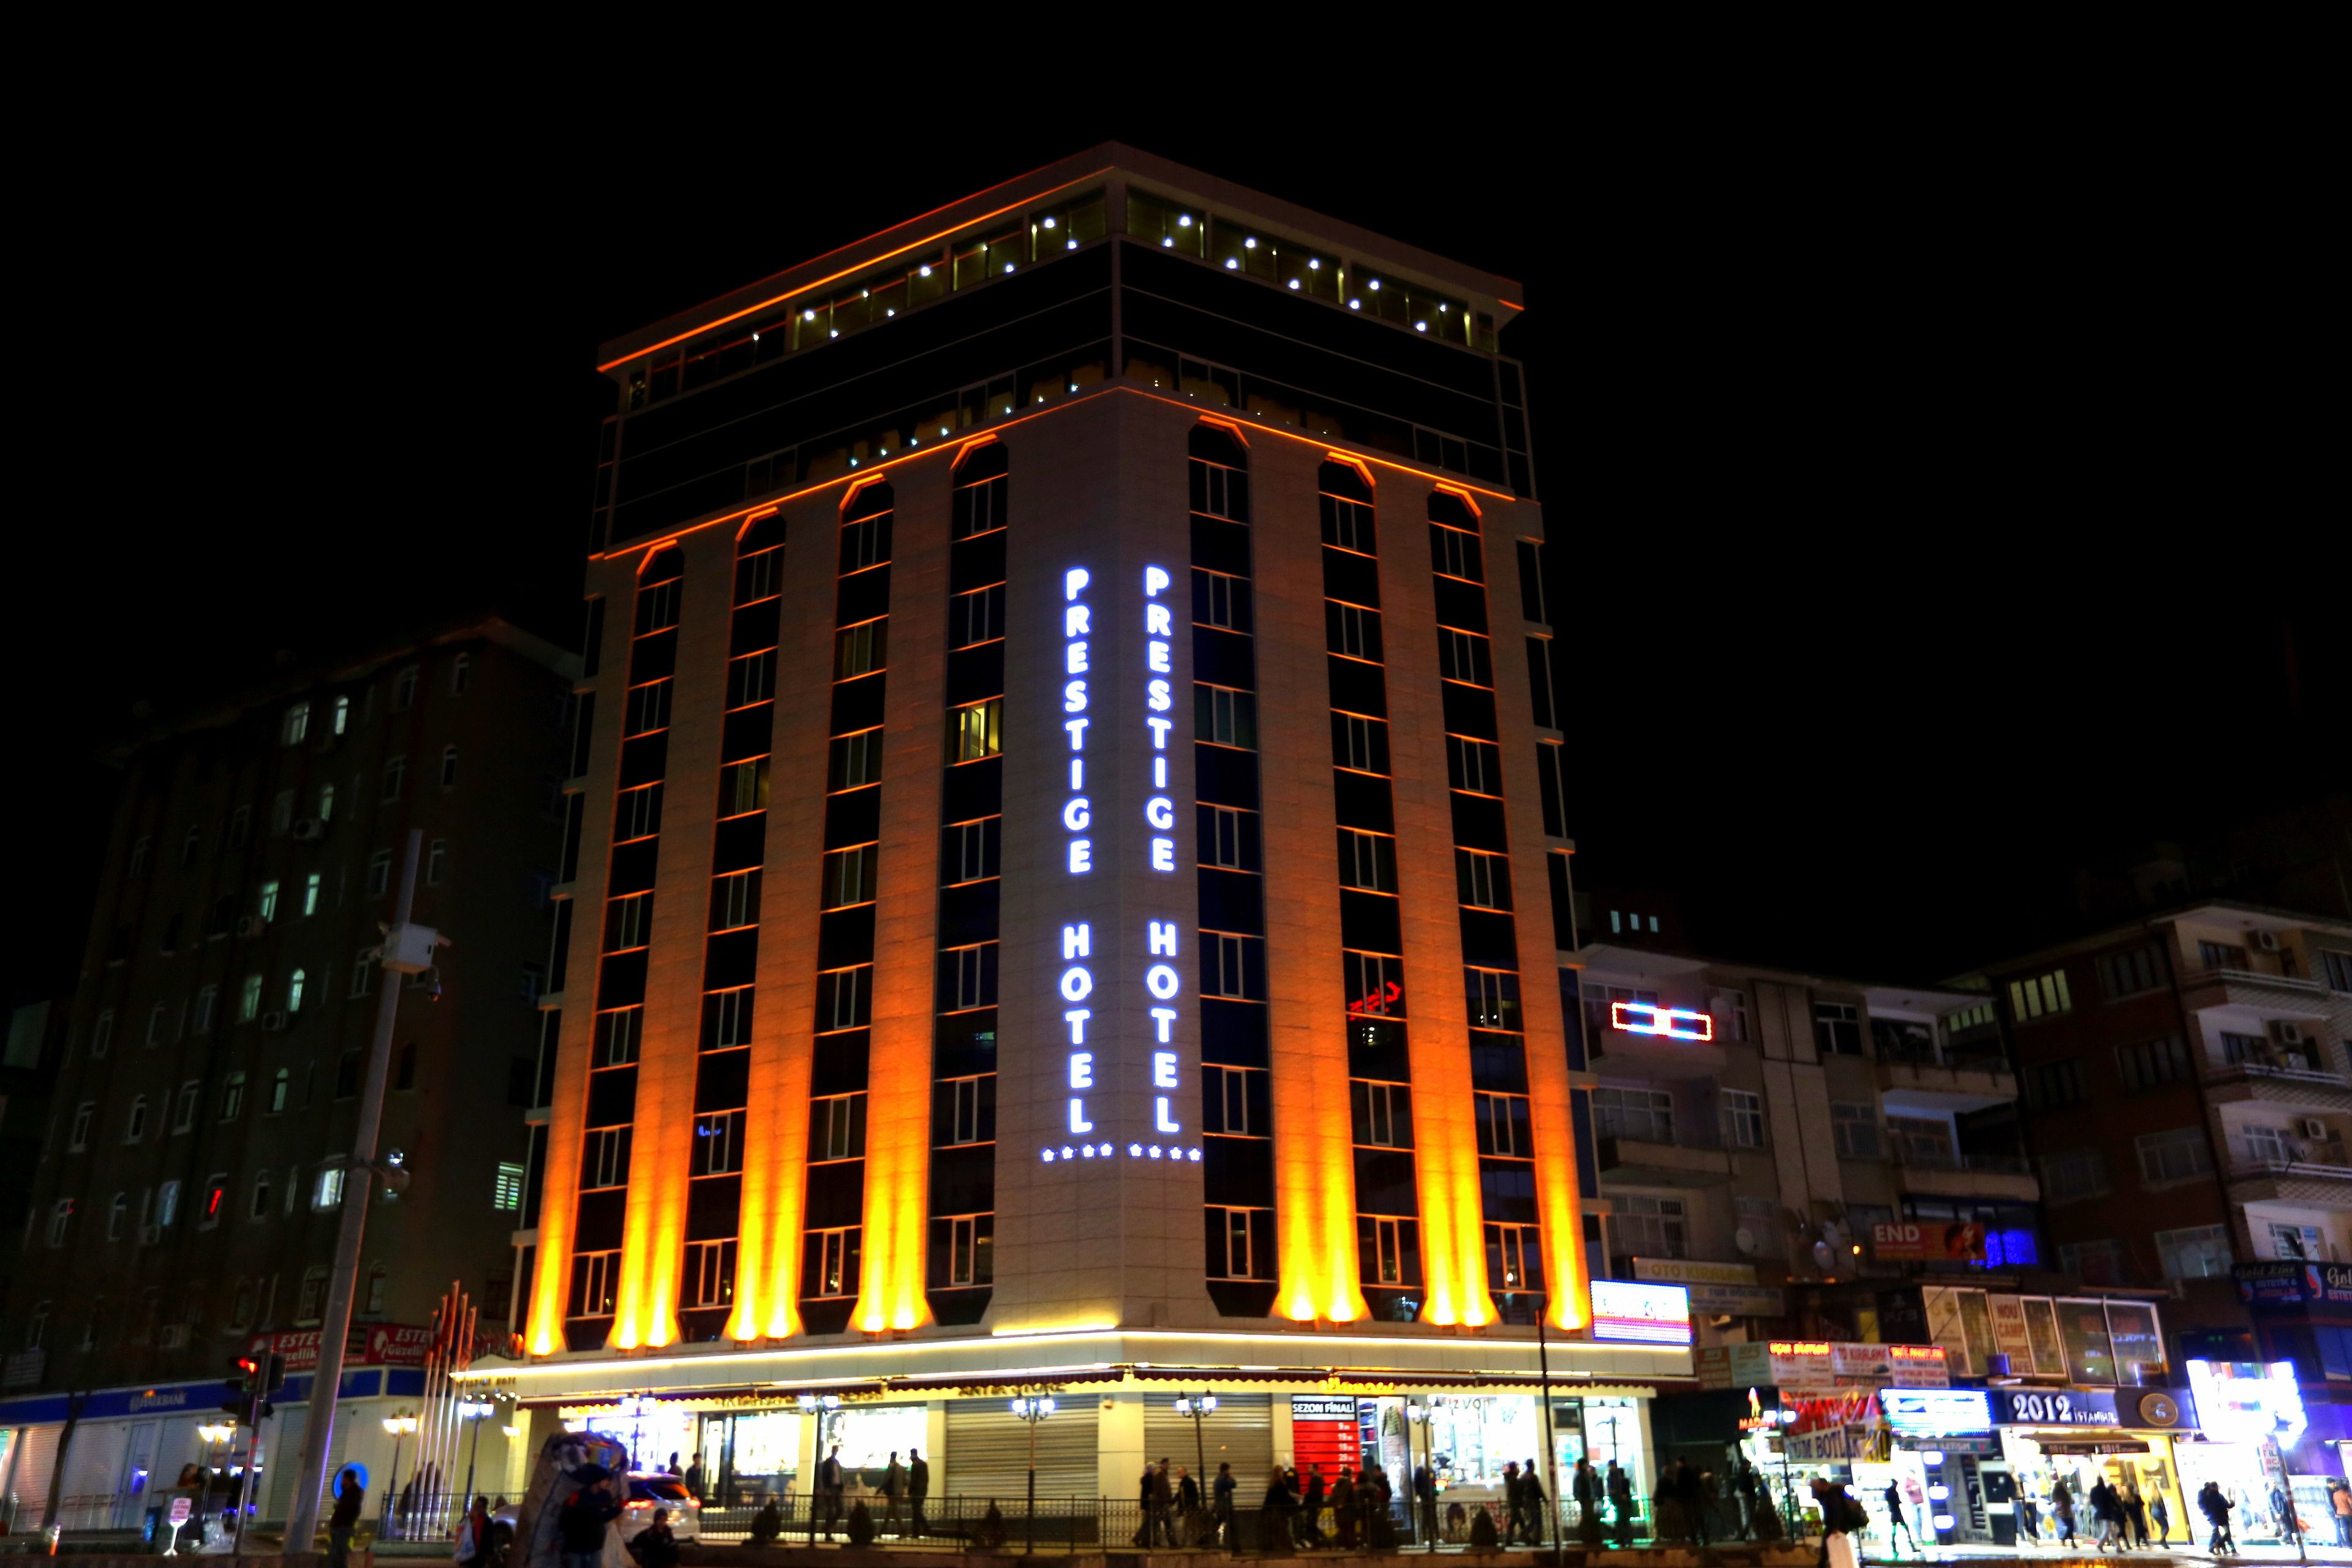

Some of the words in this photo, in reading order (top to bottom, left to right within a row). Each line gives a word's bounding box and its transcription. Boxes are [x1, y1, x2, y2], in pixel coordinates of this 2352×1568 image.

[1063, 568, 1092, 874] PRESTIGE
[1145, 566, 1175, 872] PRESTIGE
[1060, 923, 1093, 1134] HOTEL
[1147, 921, 1180, 1133] HOTEL
[1875, 1224, 1920, 1243] END
[2327, 1267, 2352, 1287] Gol
[1292, 1403, 1323, 1414] SEZON
[2013, 1393, 2072, 1422] 2012
